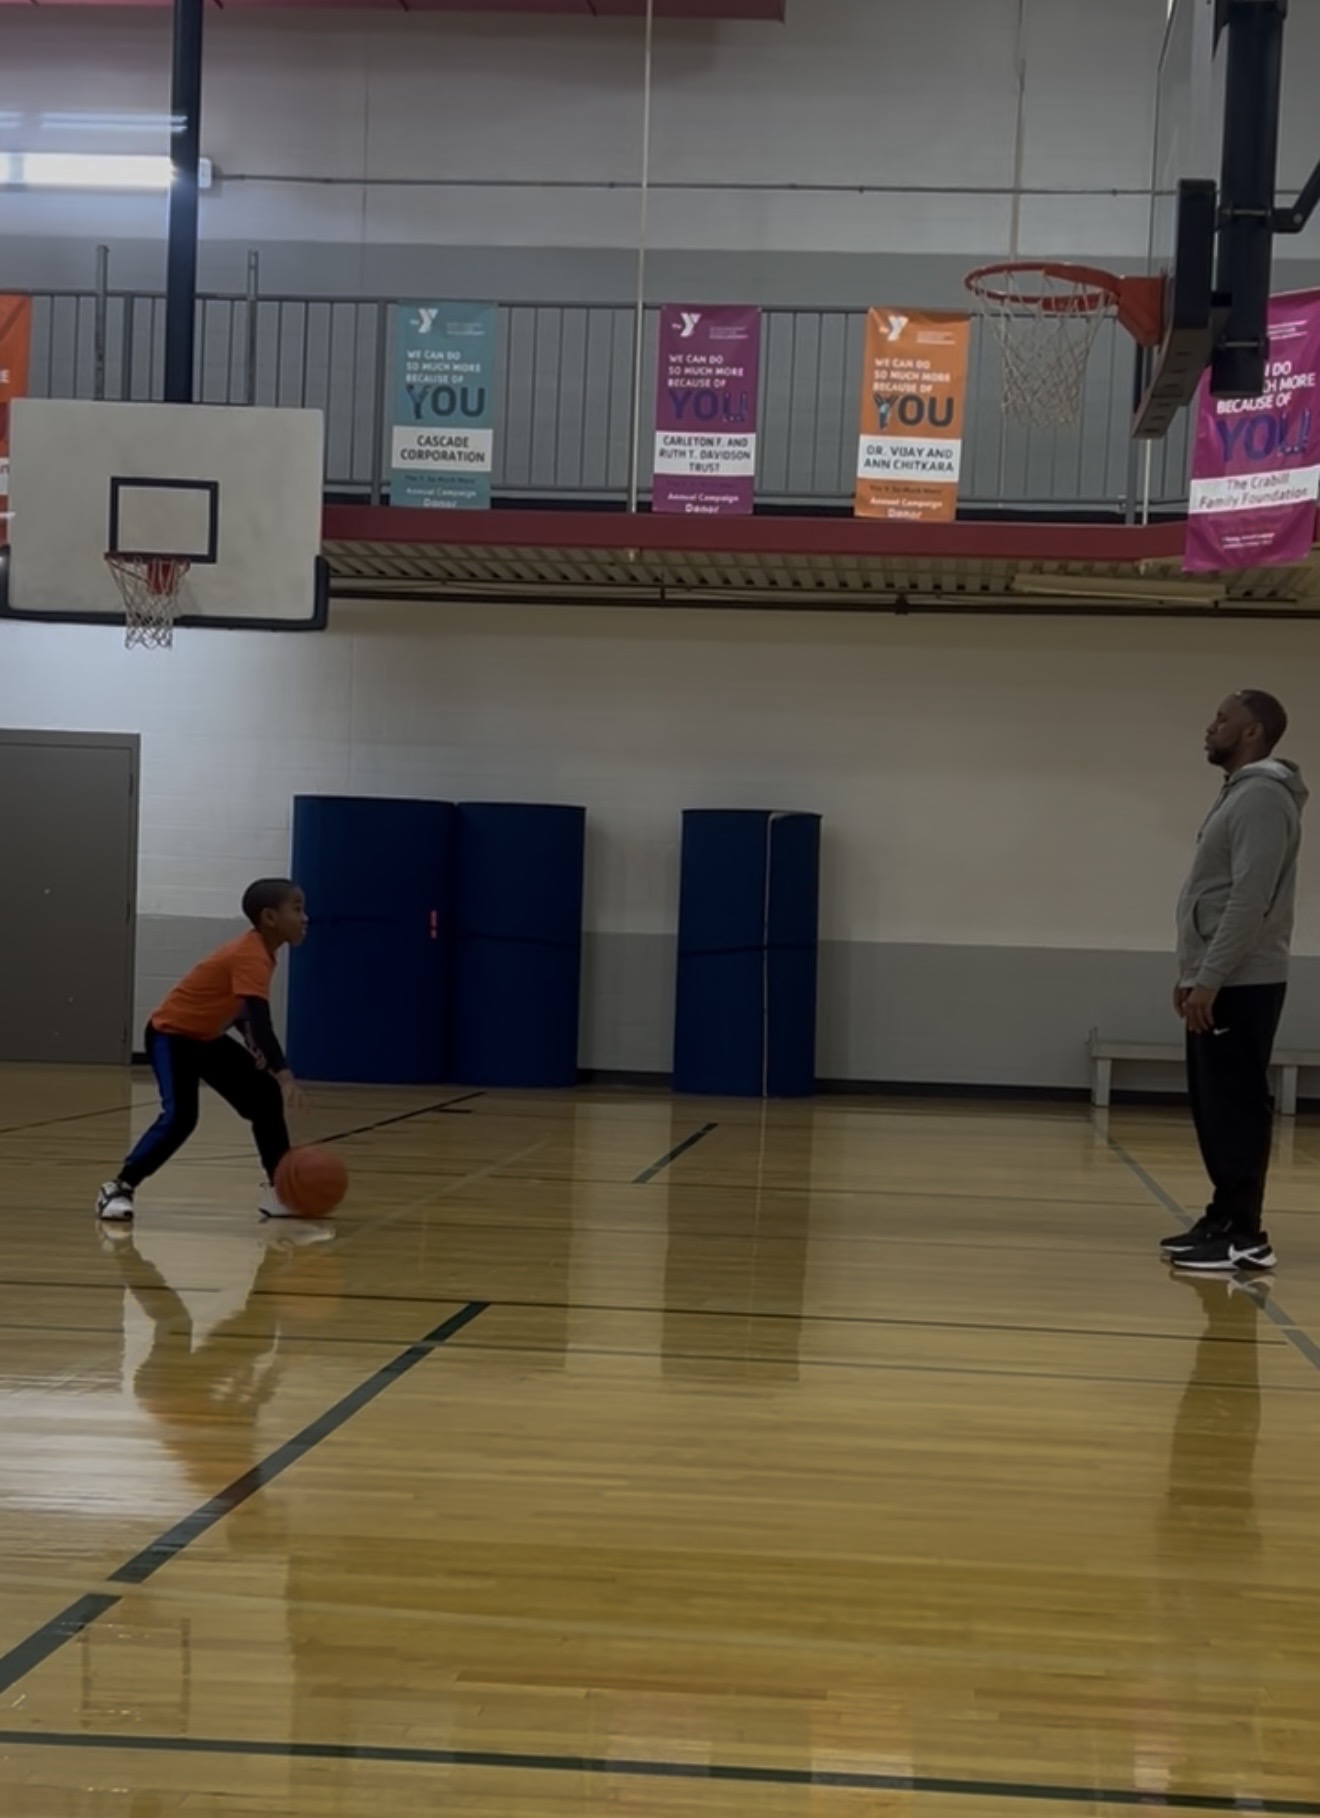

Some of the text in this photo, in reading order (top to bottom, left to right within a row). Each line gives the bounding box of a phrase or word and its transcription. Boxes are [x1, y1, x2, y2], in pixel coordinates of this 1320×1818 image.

[406, 350, 461, 361] WE CAN DO
[669, 354, 724, 364] WE CAN DO
[406, 362, 481, 373] SO MUCH MORE
[874, 358, 931, 369] WE CAN DO
[1272, 361, 1292, 377] DO
[668, 366, 744, 377] SO MUCH MORE
[873, 370, 950, 382] SO MUCH MORE
[406, 374, 464, 384] BECAUSE OF
[667, 378, 727, 388] BECAUSE OF
[1280, 372, 1316, 391] MORE
[873, 382, 933, 394] BECAUSE OF
[405, 384, 486, 420] YOU
[1217, 391, 1292, 415] BECAUSE OF
[872, 393, 954, 430] YOU
[417, 434, 470, 448] CASCADE
[663, 436, 714, 447] CARLETON
[727, 437, 748, 447] AND
[400, 448, 485, 463] CORPORATION
[659, 448, 687, 459] RUTH
[700, 449, 751, 461] DAVIDSON
[866, 445, 954, 459] DR. VIJAY AND
[689, 462, 721, 473] TRUST
[863, 459, 954, 472] ANN CHITKARA
[1227, 479, 1248, 491] The
[1200, 487, 1308, 510] Family Foundation
